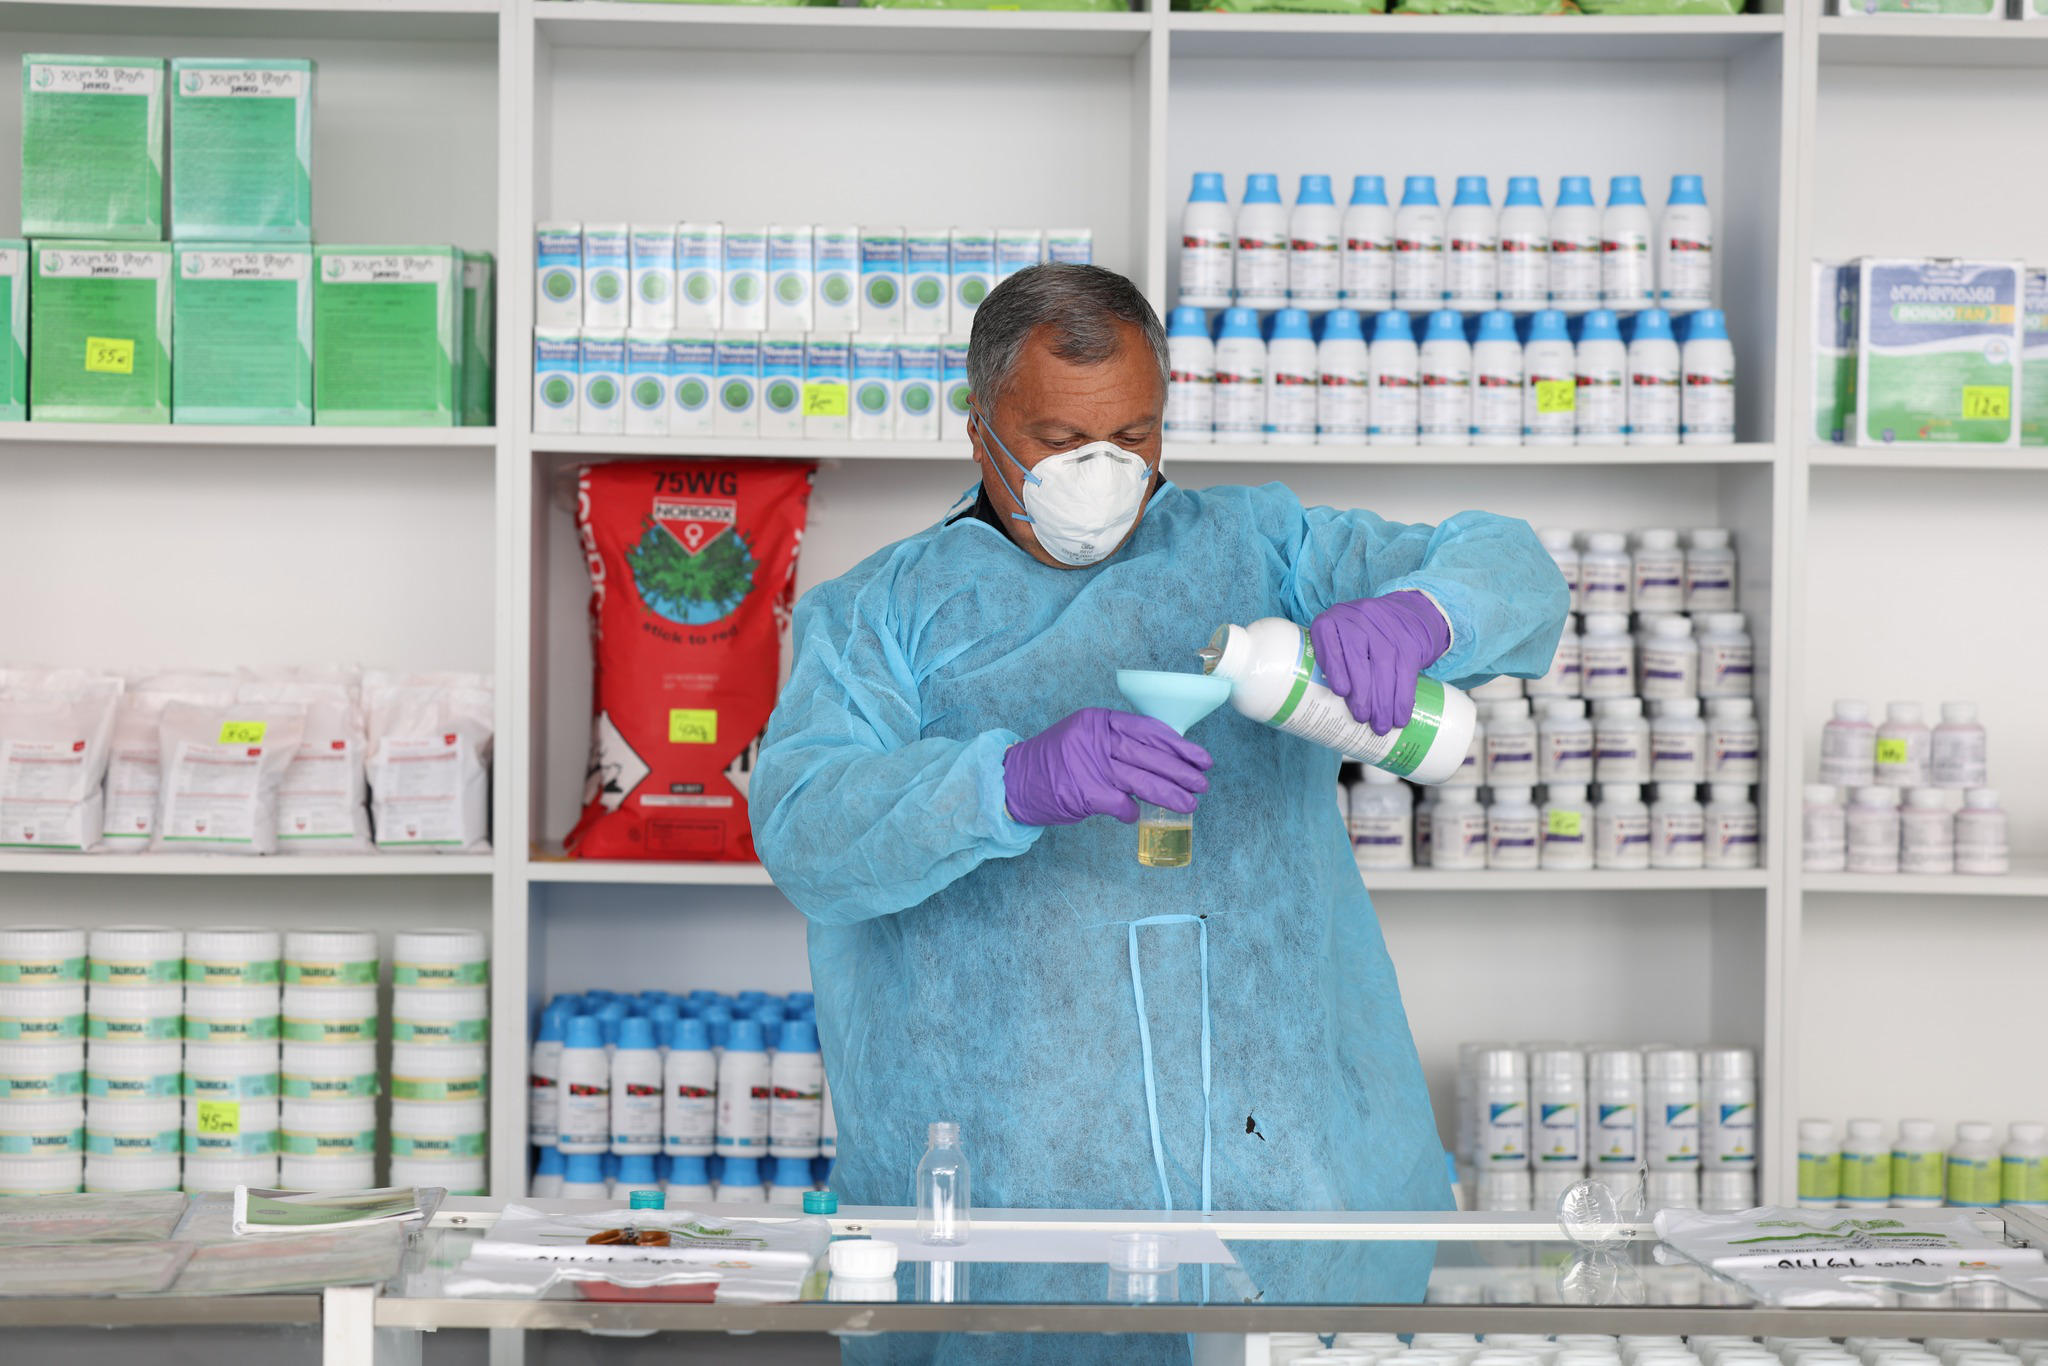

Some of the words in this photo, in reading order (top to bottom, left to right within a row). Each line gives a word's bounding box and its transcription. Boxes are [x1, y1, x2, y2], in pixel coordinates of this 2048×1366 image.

[653, 471, 737, 496] 75WG
[655, 505, 733, 520] NORDOX
[643, 621, 683, 645] stick
[688, 633, 707, 645] to
[711, 624, 739, 641] red
